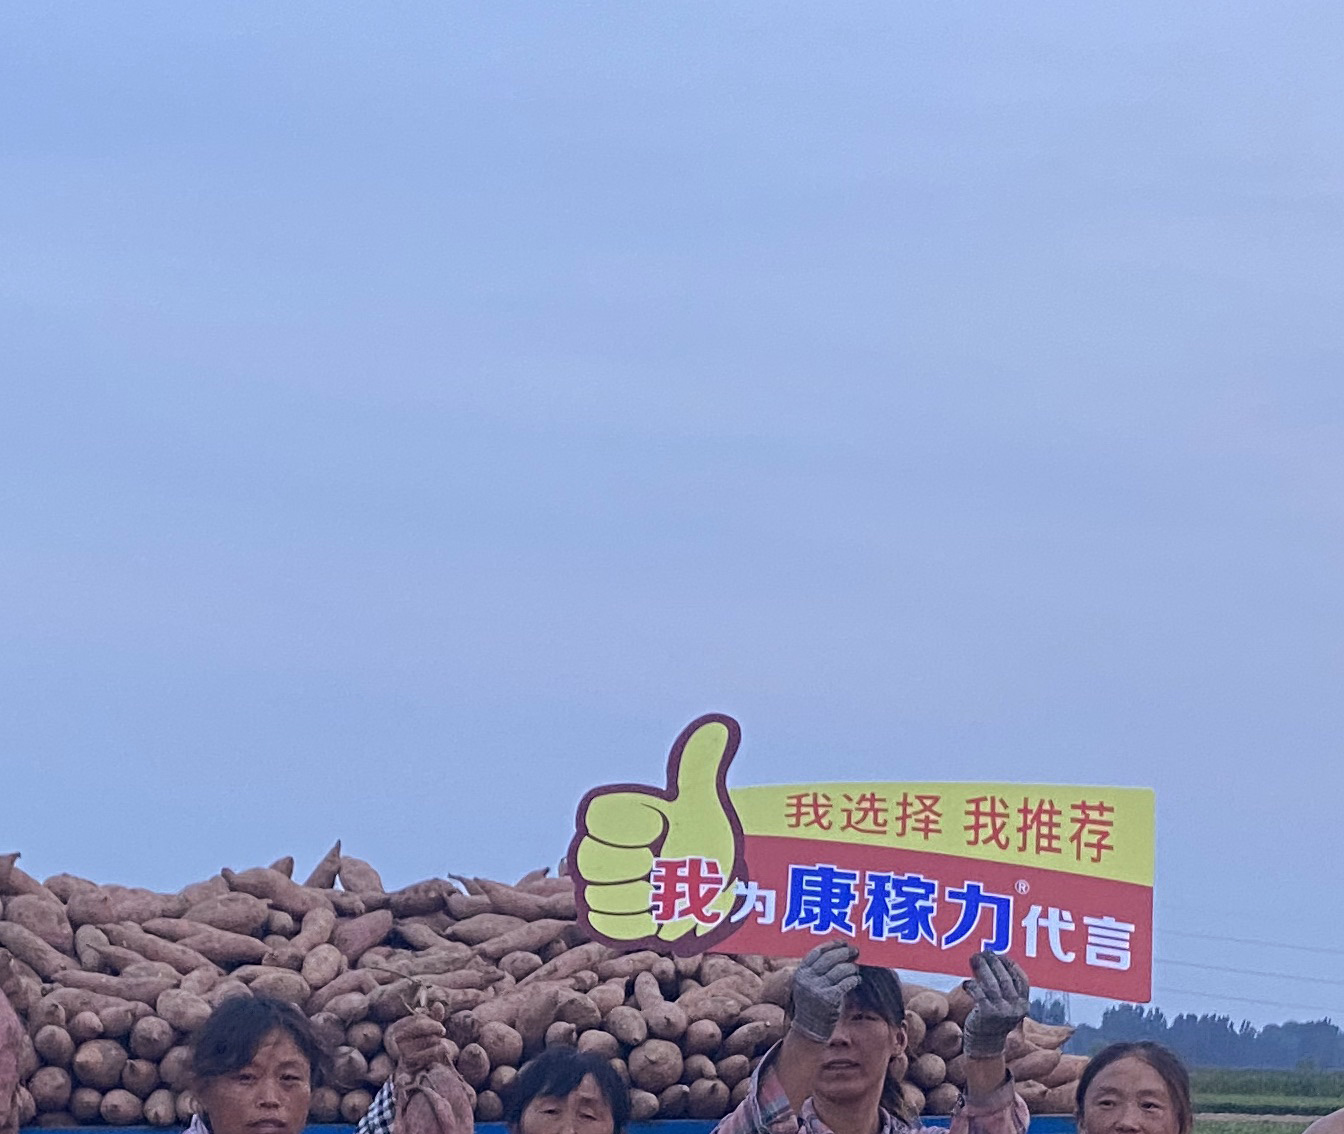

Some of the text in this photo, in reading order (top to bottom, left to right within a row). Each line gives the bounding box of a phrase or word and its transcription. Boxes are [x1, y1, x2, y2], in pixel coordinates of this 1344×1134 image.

[784, 791, 1115, 864] 我选择 我推荐
